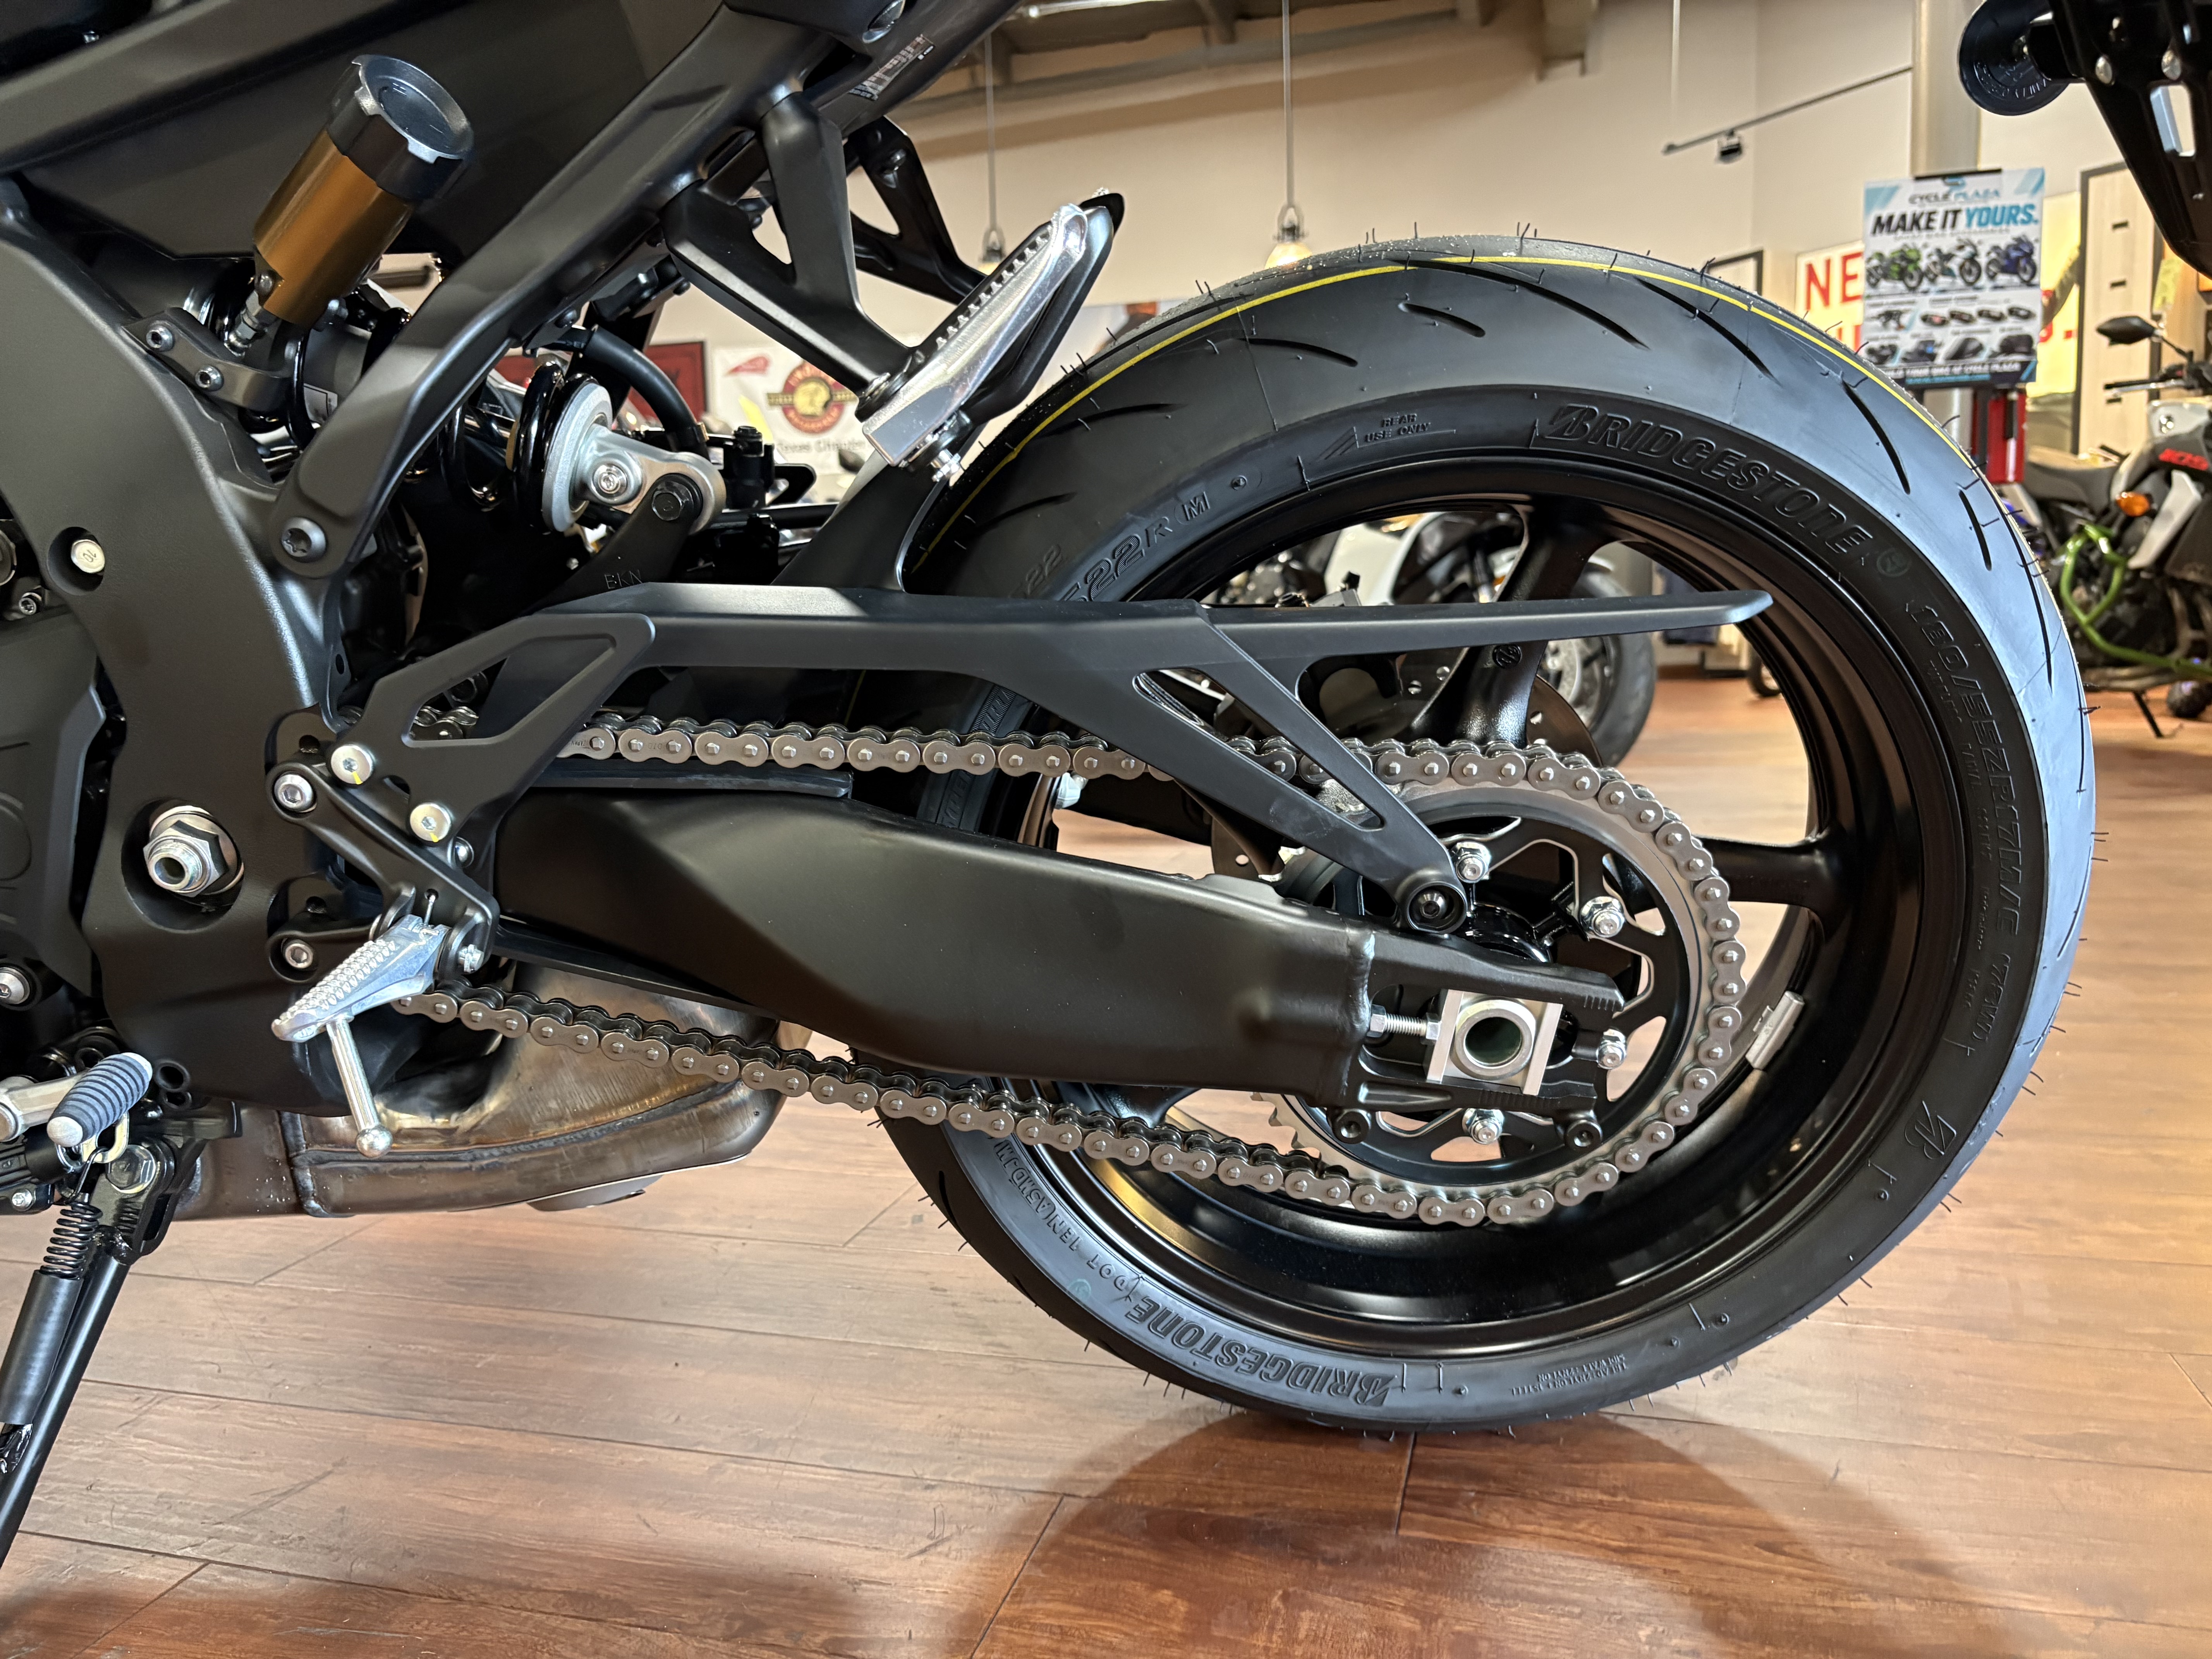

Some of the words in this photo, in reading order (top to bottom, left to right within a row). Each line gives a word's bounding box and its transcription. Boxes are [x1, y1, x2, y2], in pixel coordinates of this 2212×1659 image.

[1908, 192, 1949, 204] CYCLE
[1870, 210, 1937, 236] MAKE
[1941, 209, 1962, 229] IT
[1965, 203, 2039, 228] YOURS.
[1806, 252, 1862, 311] NE
[1364, 429, 1392, 443] USE
[1397, 422, 1431, 436] ONLY
[1380, 413, 1417, 428] REAR
[1544, 404, 1873, 555] BRIDGESTONE
[1087, 1254, 1128, 1291] DOT
[1125, 1295, 1397, 1407] BRIDGESTONE
